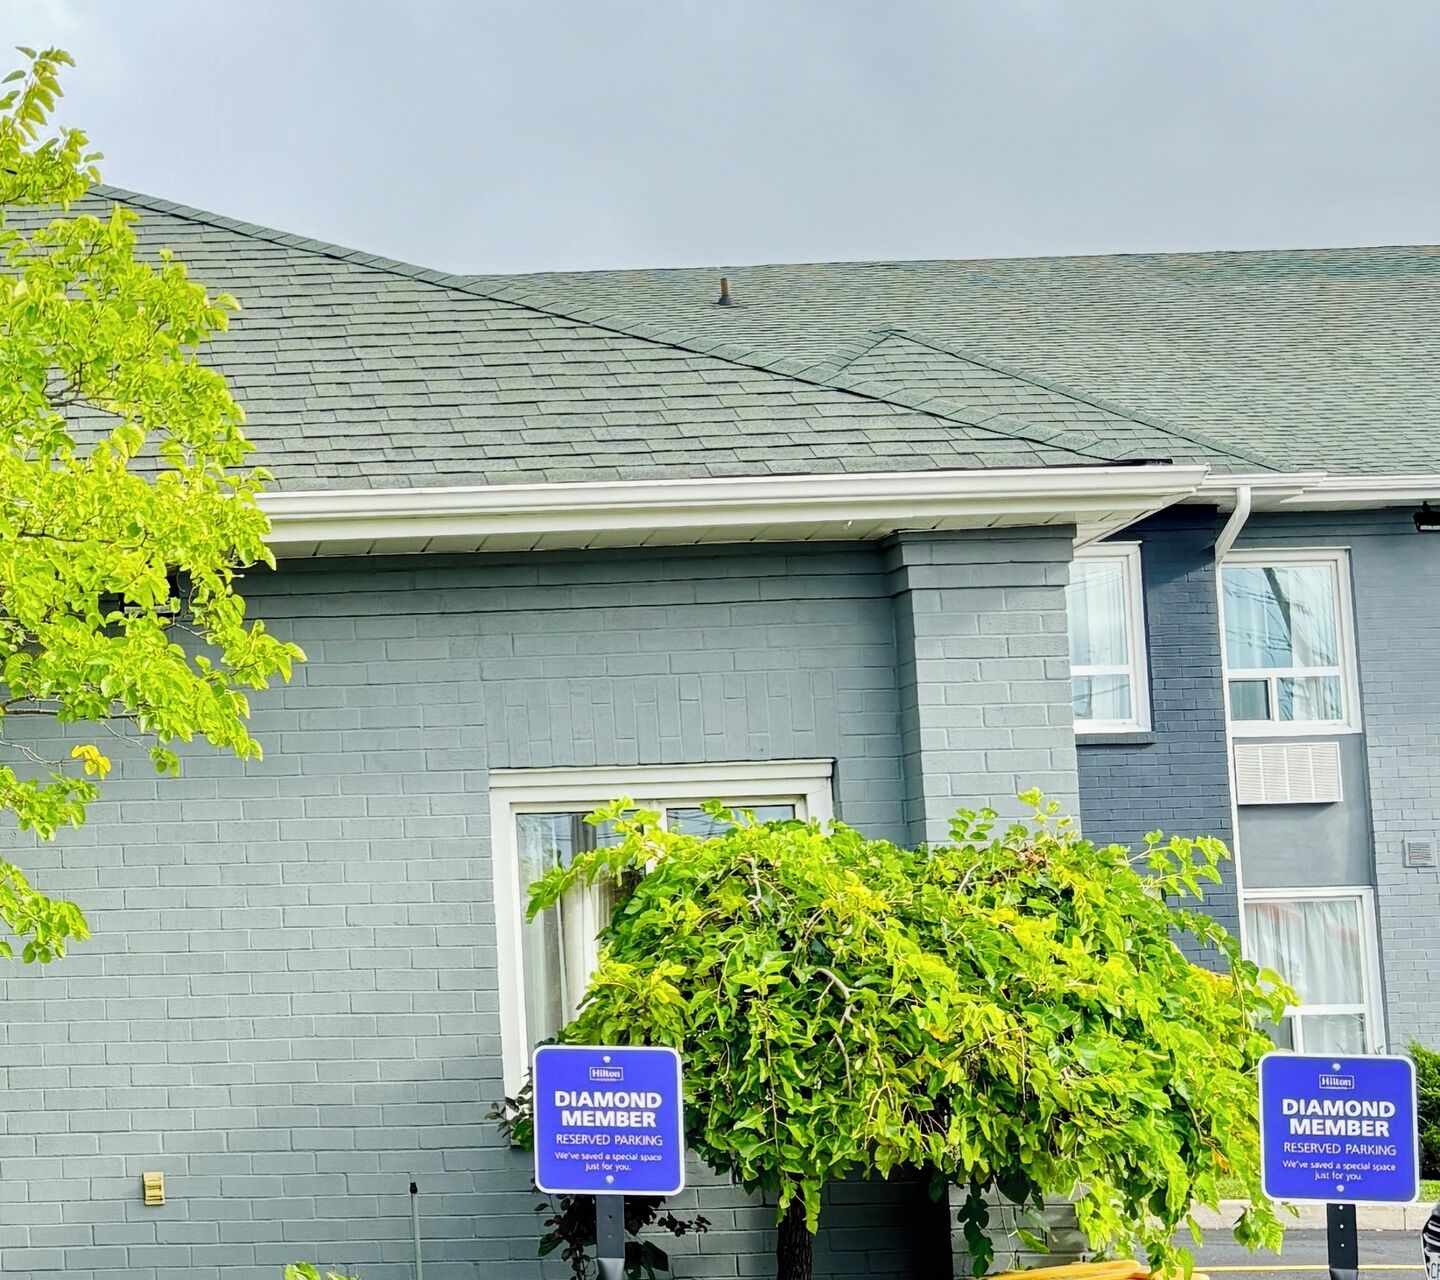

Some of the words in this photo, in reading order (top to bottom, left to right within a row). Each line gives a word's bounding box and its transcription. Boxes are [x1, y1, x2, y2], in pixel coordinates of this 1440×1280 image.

[592, 1069, 620, 1078] Hilton
[1322, 1077, 1352, 1087] Hilton
[554, 1090, 662, 1108] DIAMOND
[1282, 1098, 1396, 1118] DIAMOND
[561, 1110, 656, 1128] MEMBER
[1289, 1118, 1389, 1138] MEMBER
[556, 1134, 610, 1145] RESERVED
[614, 1135, 662, 1146] PARKING
[1284, 1142, 1341, 1154] RESERVED
[1346, 1144, 1397, 1156] PARKING
[555, 1152, 579, 1160] We've
[581, 1152, 604, 1160] saved
[612, 1152, 638, 1162] special
[641, 1154, 662, 1162] space
[585, 1162, 600, 1172] just
[602, 1162, 613, 1170] for
[615, 1163, 632, 1172] you.
[1283, 1160, 1308, 1168] We've
[1310, 1161, 1334, 1169] saved
[1343, 1162, 1370, 1172] special
[1372, 1163, 1396, 1172] space
[1315, 1171, 1330, 1181] just
[1346, 1173, 1364, 1181] you.
